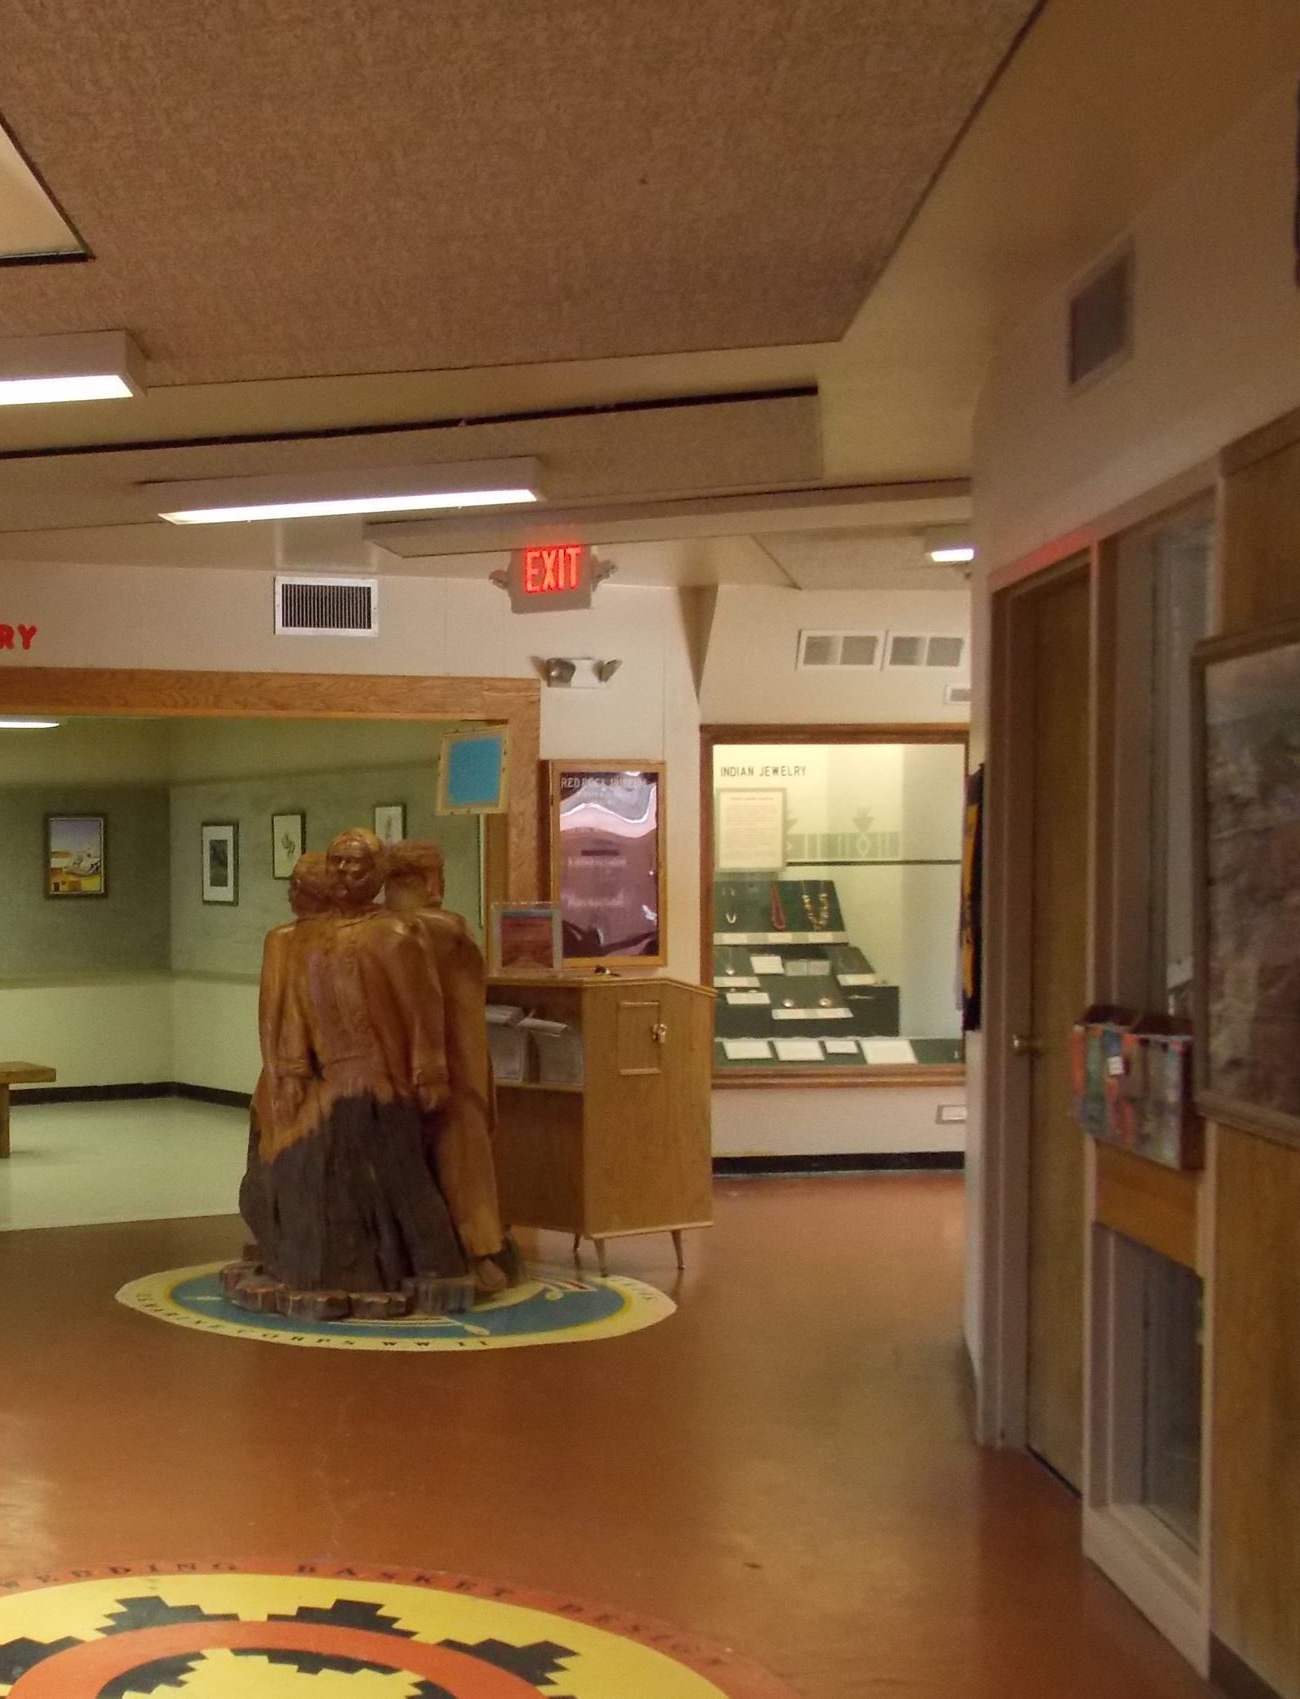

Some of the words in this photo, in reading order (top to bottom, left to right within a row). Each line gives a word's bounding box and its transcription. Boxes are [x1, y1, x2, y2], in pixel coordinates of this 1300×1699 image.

[525, 546, 582, 592] EXIT
[720, 766, 755, 777] INDIAN
[758, 765, 807, 777] JEWELRY
[561, 777, 580, 788] RED
